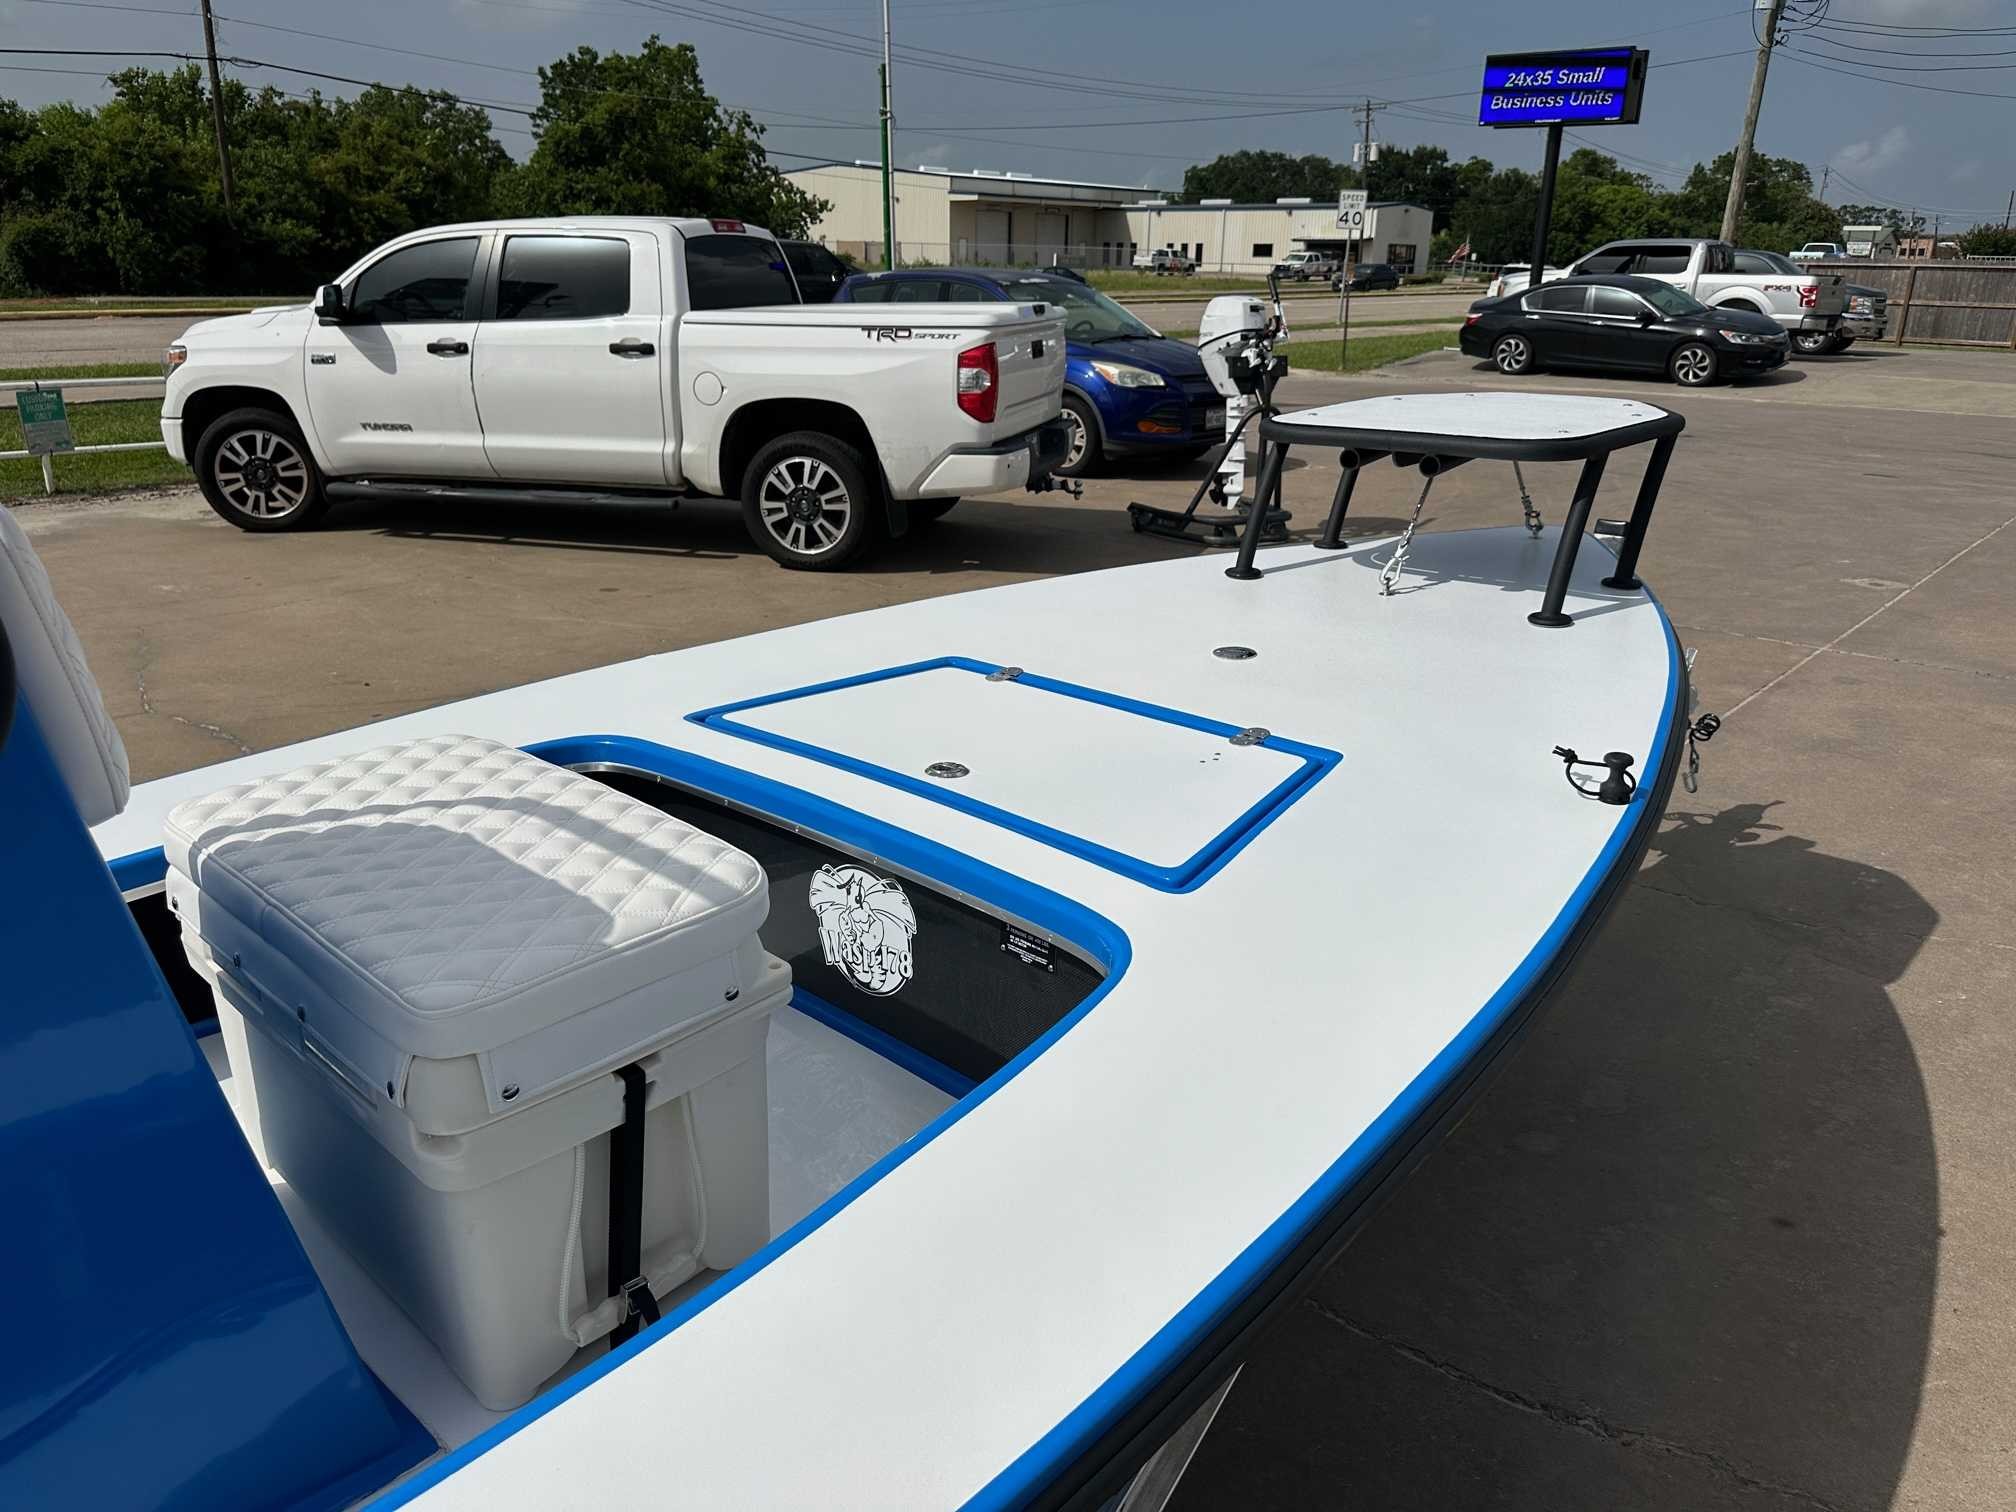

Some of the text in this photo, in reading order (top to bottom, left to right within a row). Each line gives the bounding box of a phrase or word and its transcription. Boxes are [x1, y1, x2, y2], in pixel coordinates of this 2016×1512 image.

[1504, 67, 1606, 88] 24x35 Small
[1490, 89, 1613, 110] Business Units
[1342, 193, 1365, 202] SPEED
[1338, 210, 1362, 226] 40
[861, 327, 912, 342] TRD
